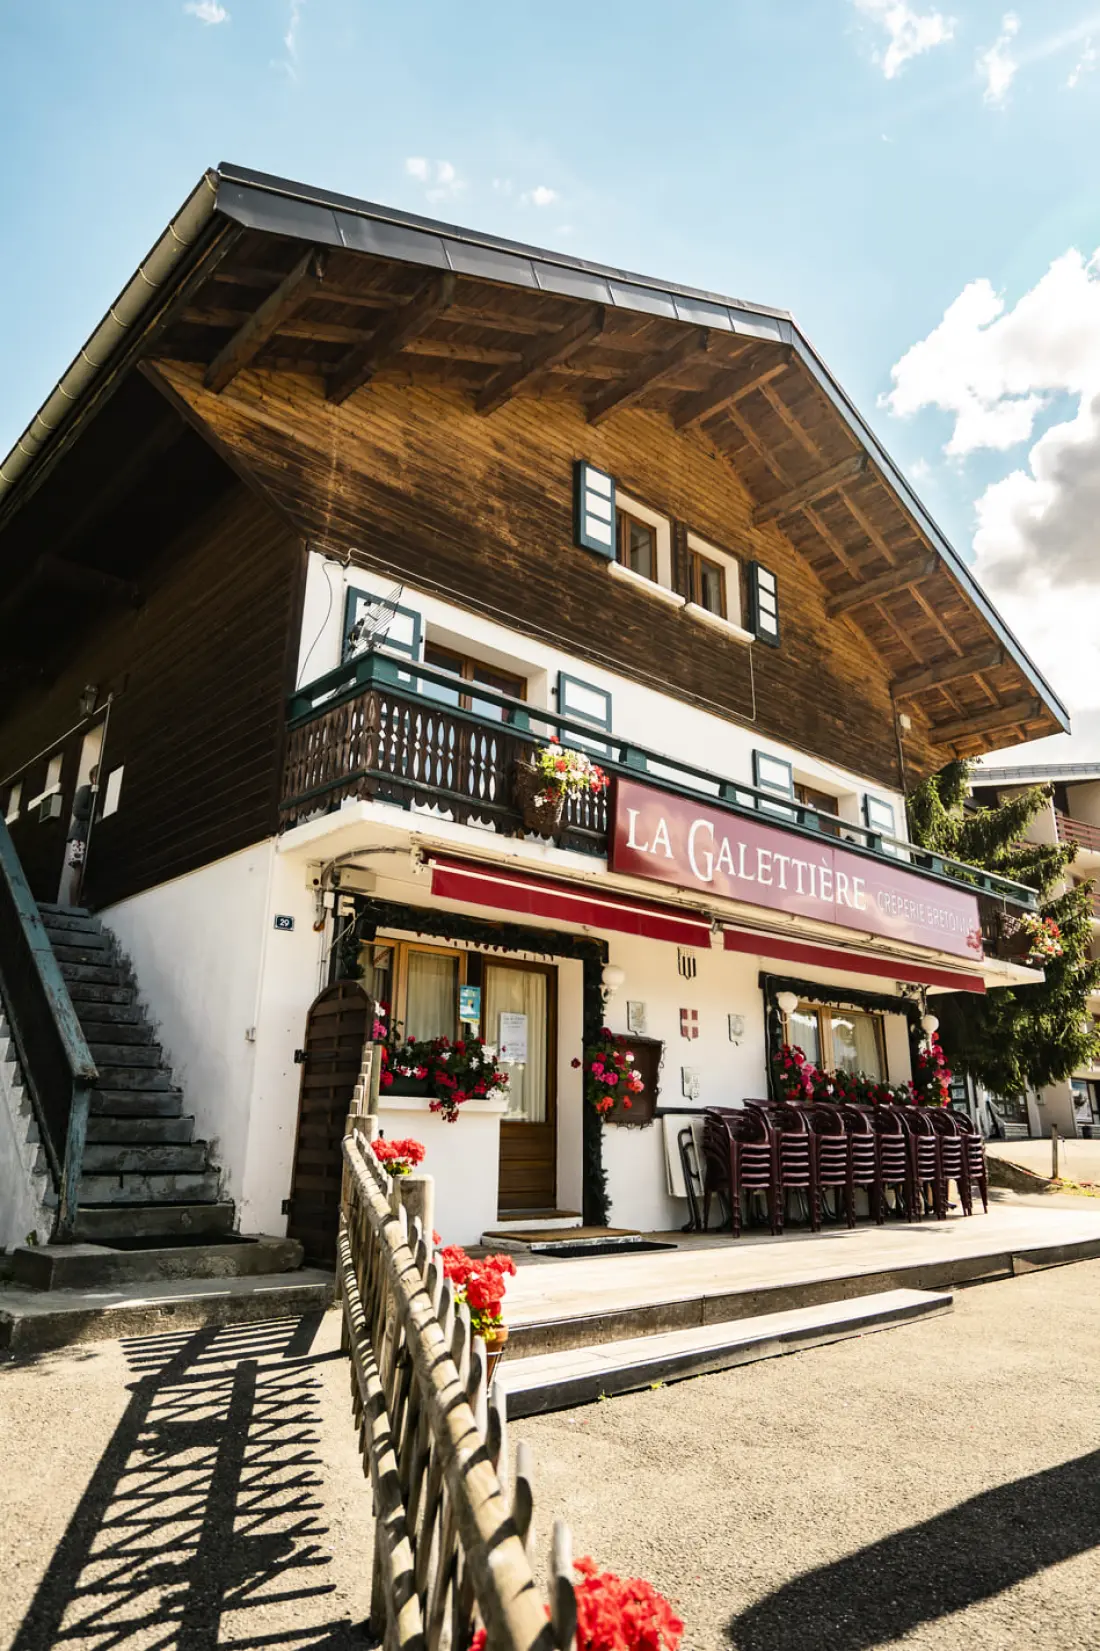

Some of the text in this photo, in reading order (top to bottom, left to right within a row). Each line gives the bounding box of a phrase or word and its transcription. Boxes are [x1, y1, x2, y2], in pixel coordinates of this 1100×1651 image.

[626, 808, 867, 911] LA GALETTIÈRE
[279, 918, 290, 927] 29
